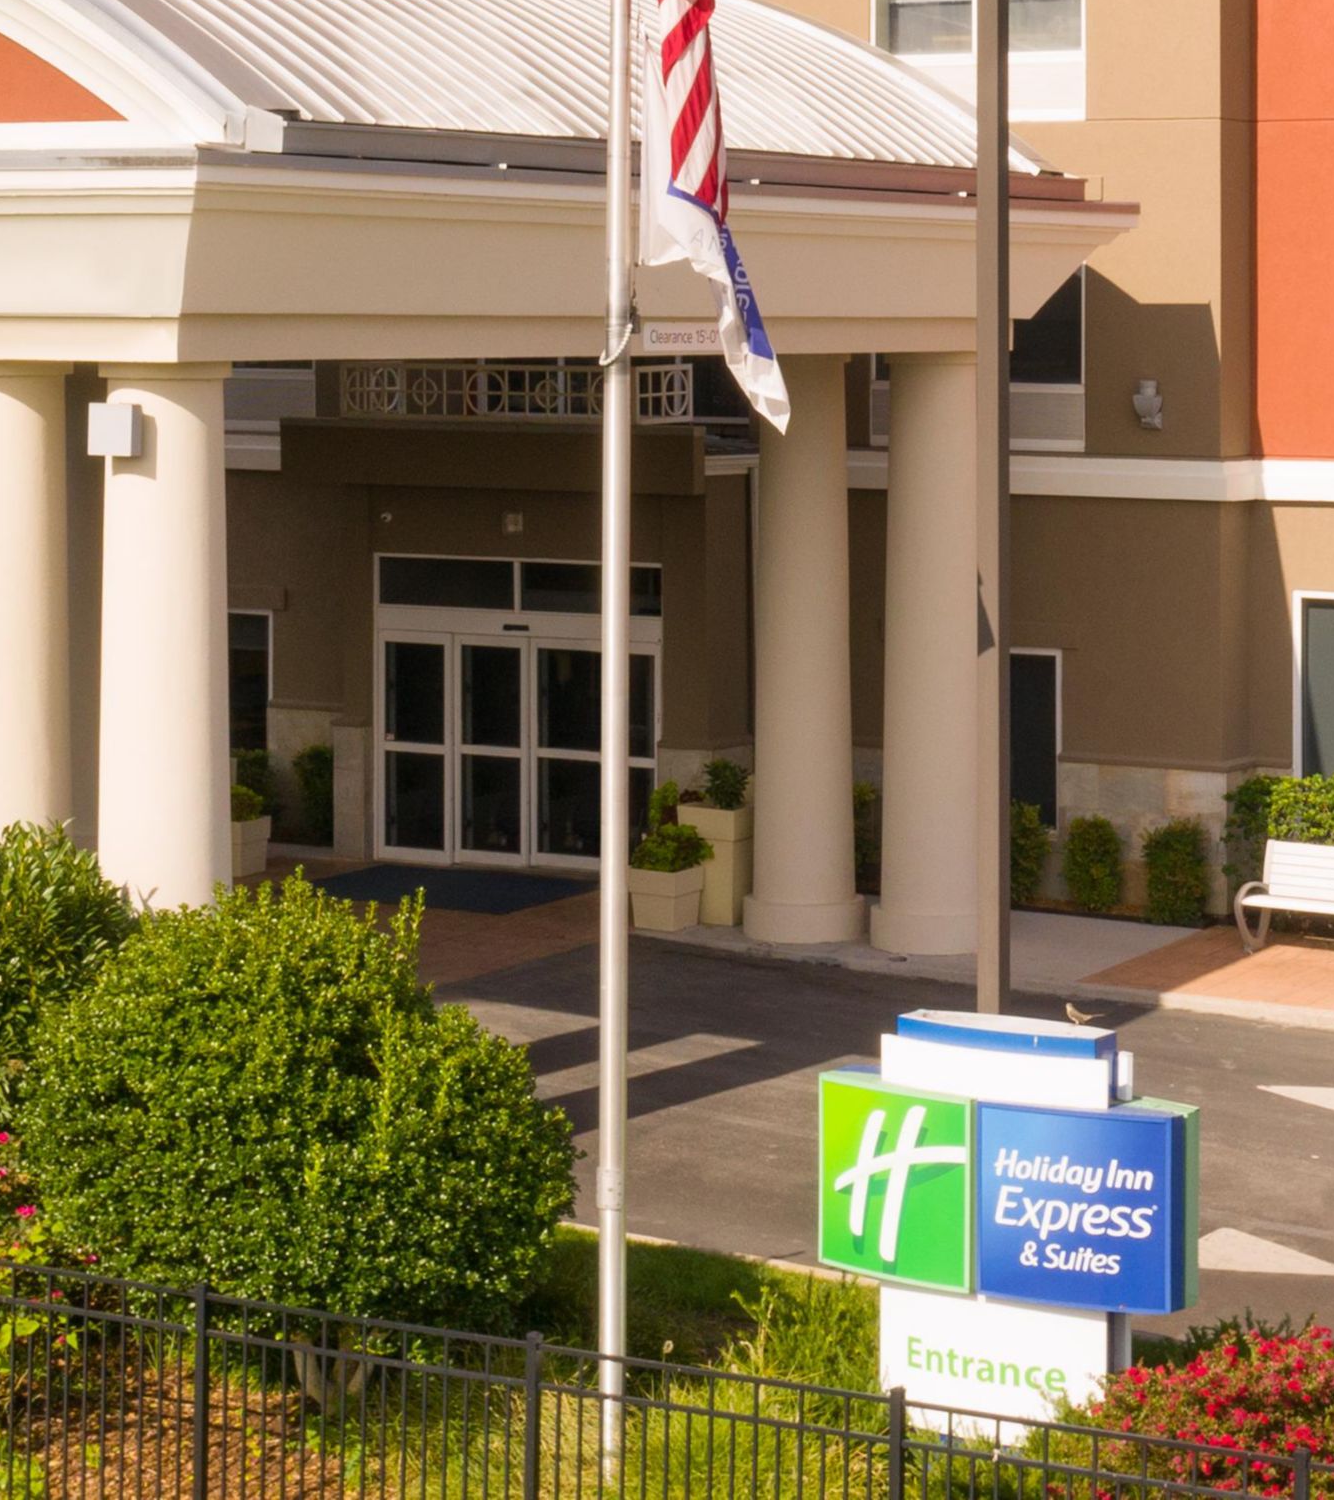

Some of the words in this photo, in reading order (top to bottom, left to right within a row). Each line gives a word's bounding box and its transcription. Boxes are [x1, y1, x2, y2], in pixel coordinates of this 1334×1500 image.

[650, 328, 693, 345] Clearance
[993, 1147, 1104, 1194] Holiday
[1105, 1158, 1154, 1192] Inn
[994, 1184, 1155, 1241] Express
[1019, 1240, 1039, 1268] &
[1042, 1243, 1122, 1276] Suites
[907, 1335, 1067, 1393] Entrance
